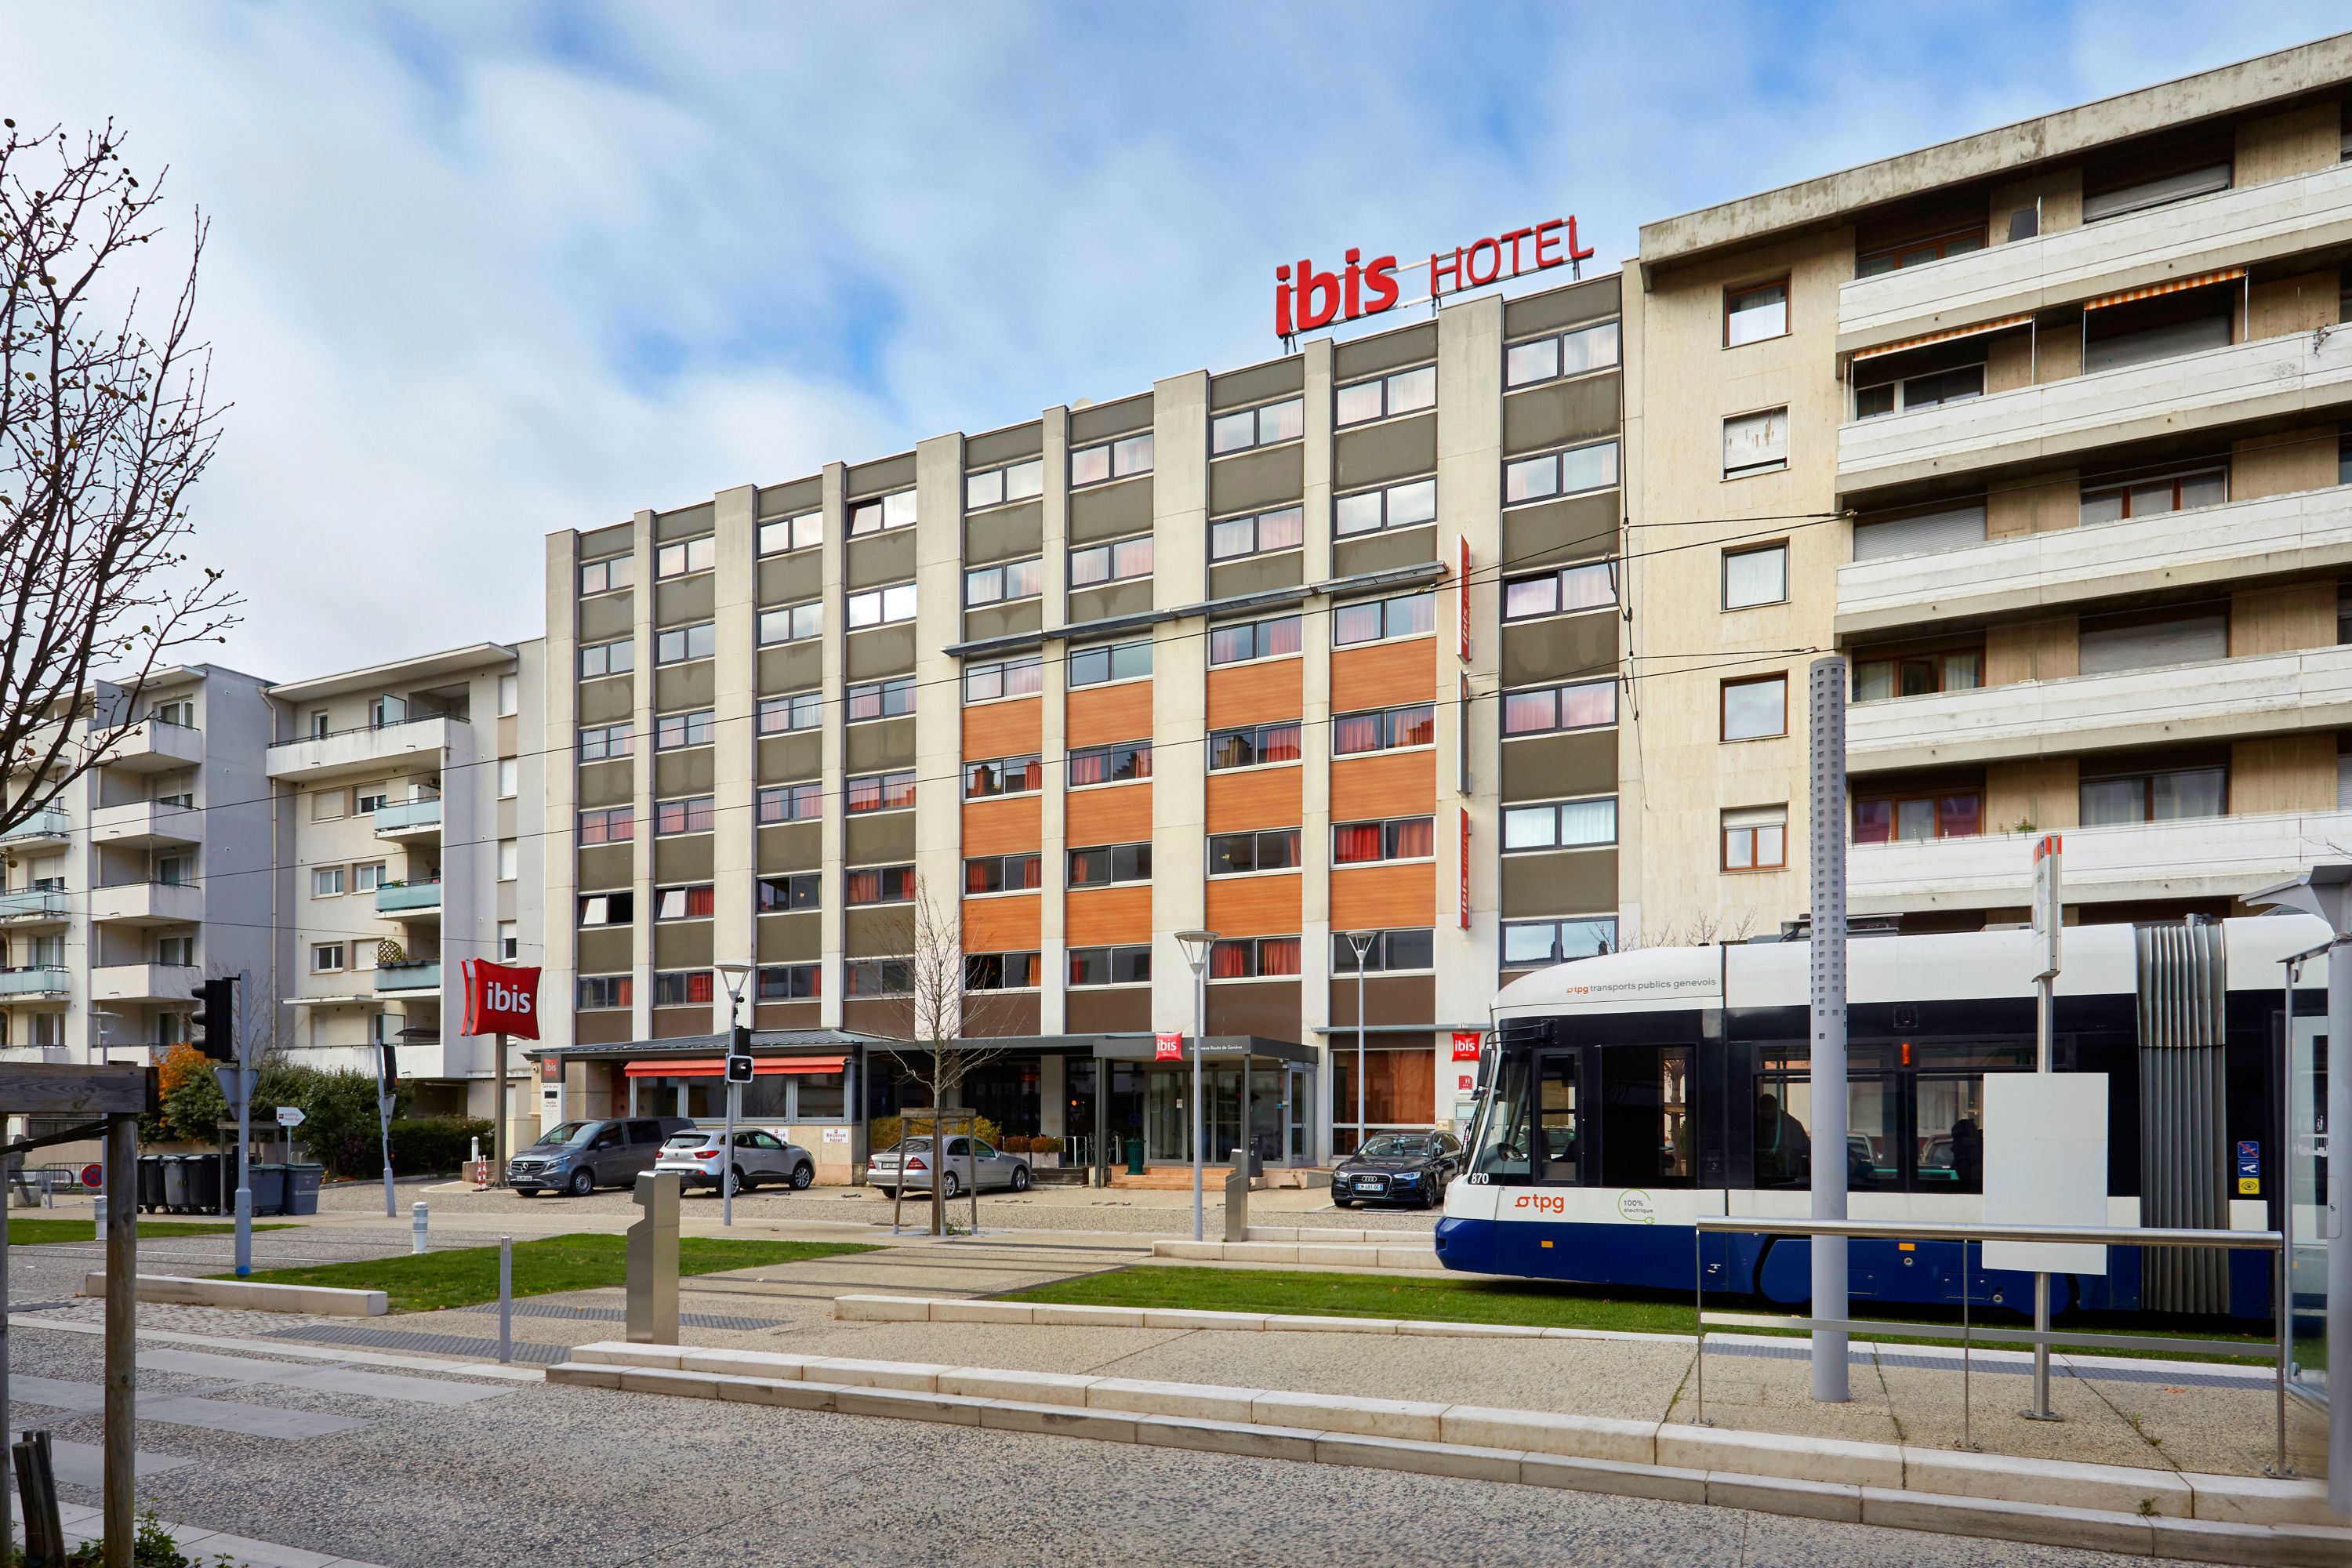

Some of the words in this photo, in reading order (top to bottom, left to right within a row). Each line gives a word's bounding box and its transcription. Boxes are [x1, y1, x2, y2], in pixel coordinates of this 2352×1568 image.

[1276, 247, 1399, 337] ibis
[1431, 214, 1594, 297] HOTEL
[1590, 982, 1635, 993] transports
[1638, 981, 1671, 991] publics
[1673, 978, 1717, 989] genevois
[487, 981, 531, 1014] ibis
[1157, 1039, 1177, 1051] ibis
[1455, 1040, 1475, 1051] ibis
[545, 1062, 557, 1072] ibis
[1471, 1172, 1489, 1184] 870
[1533, 1194, 1564, 1214] tpg
